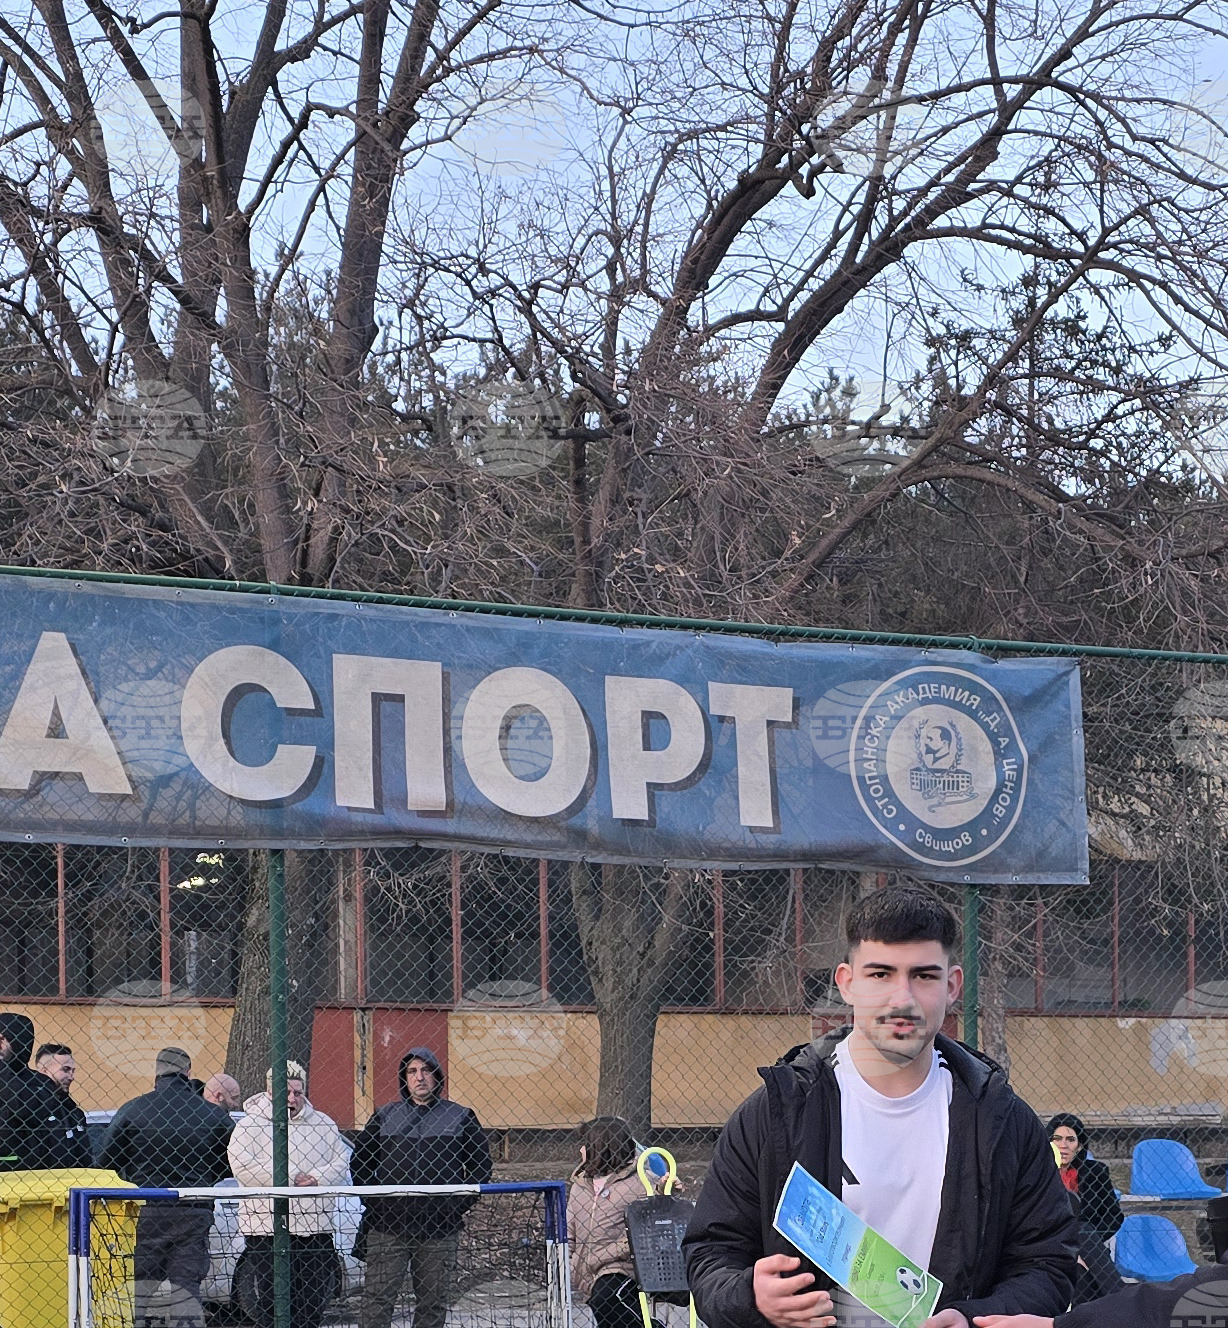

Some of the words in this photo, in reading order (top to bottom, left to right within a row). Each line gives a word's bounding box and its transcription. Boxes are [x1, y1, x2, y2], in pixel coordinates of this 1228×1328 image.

[181, 644, 795, 829] СПОРТ
[862, 714, 897, 819] СТОПАНСКА
[886, 683, 981, 714] АКАДЕМИЯ
